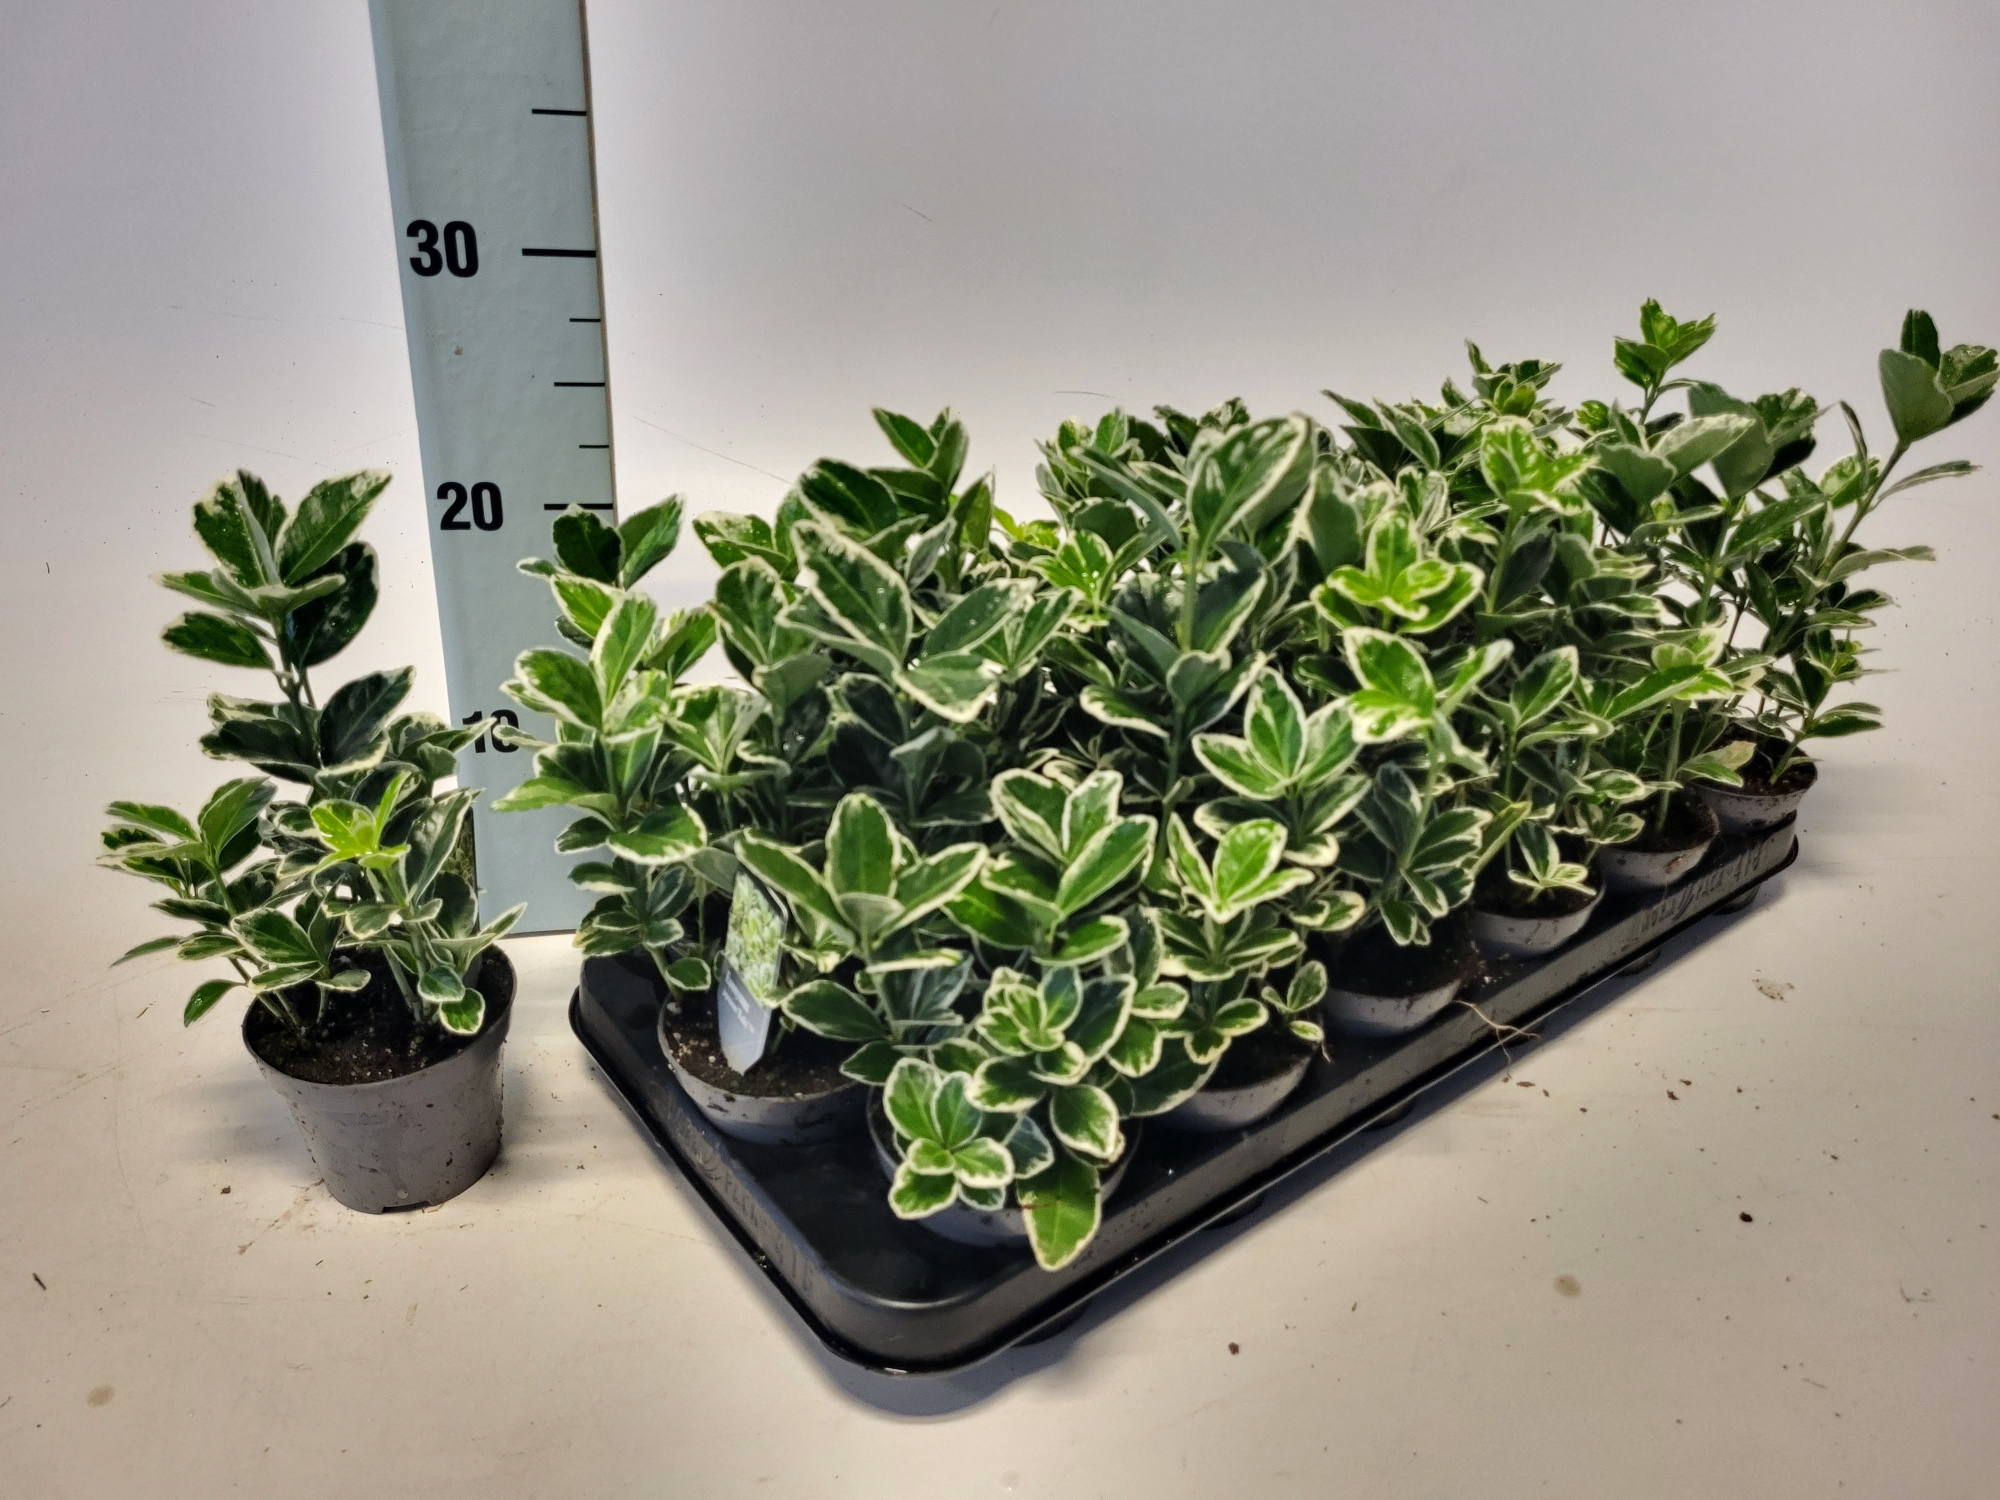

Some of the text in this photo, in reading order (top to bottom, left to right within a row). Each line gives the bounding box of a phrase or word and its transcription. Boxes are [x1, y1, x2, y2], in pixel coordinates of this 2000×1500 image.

[406, 219, 479, 278] 30
[436, 481, 504, 531] 20
[462, 709, 519, 753] 10
